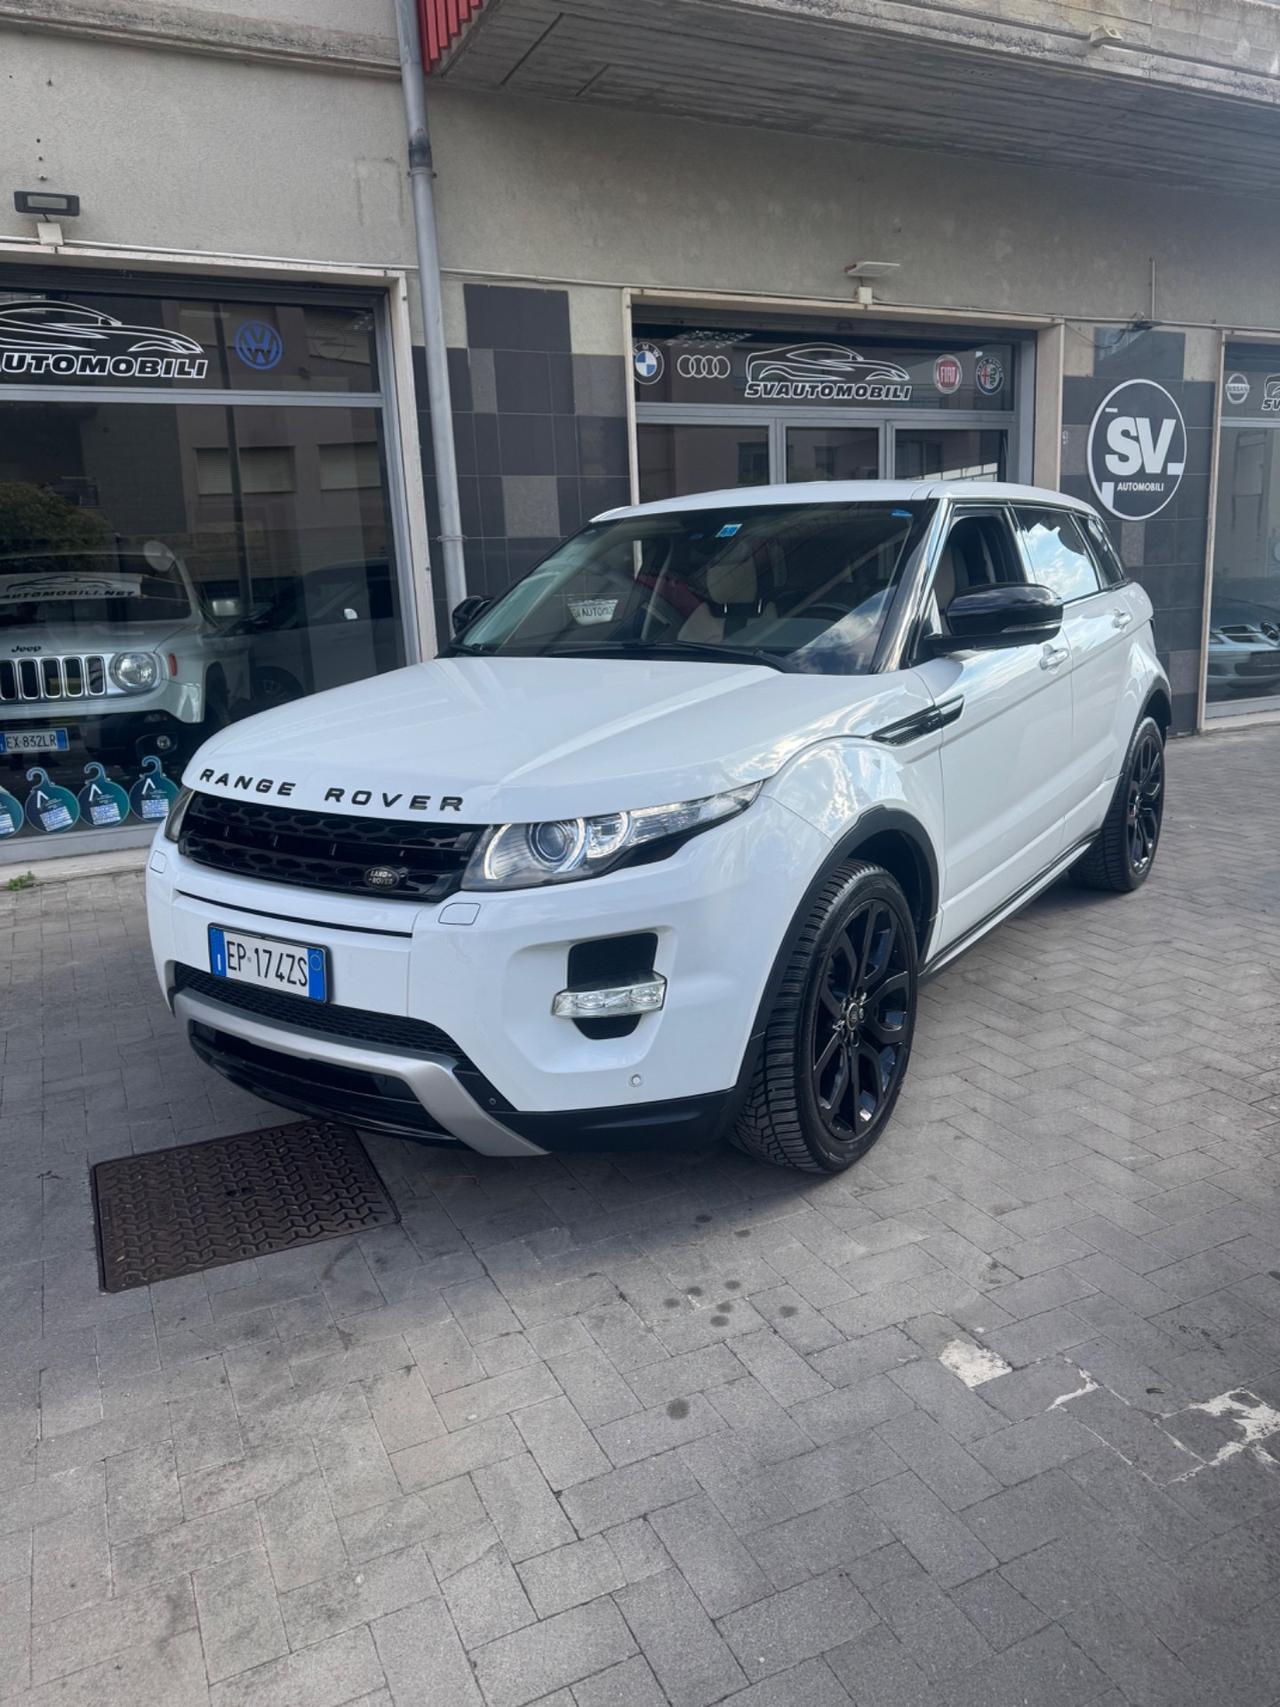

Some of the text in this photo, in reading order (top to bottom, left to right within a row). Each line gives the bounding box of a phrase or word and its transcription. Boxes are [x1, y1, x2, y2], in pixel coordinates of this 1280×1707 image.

[0, 352, 208, 379] UTOMOBILI
[744, 382, 912, 400] SVAUTOMOBILI
[1105, 416, 1177, 476] SV
[1117, 482, 1164, 492] AUTOMOBILI
[11, 645, 42, 653] Jeep
[200, 768, 464, 811] RANGE ROVER
